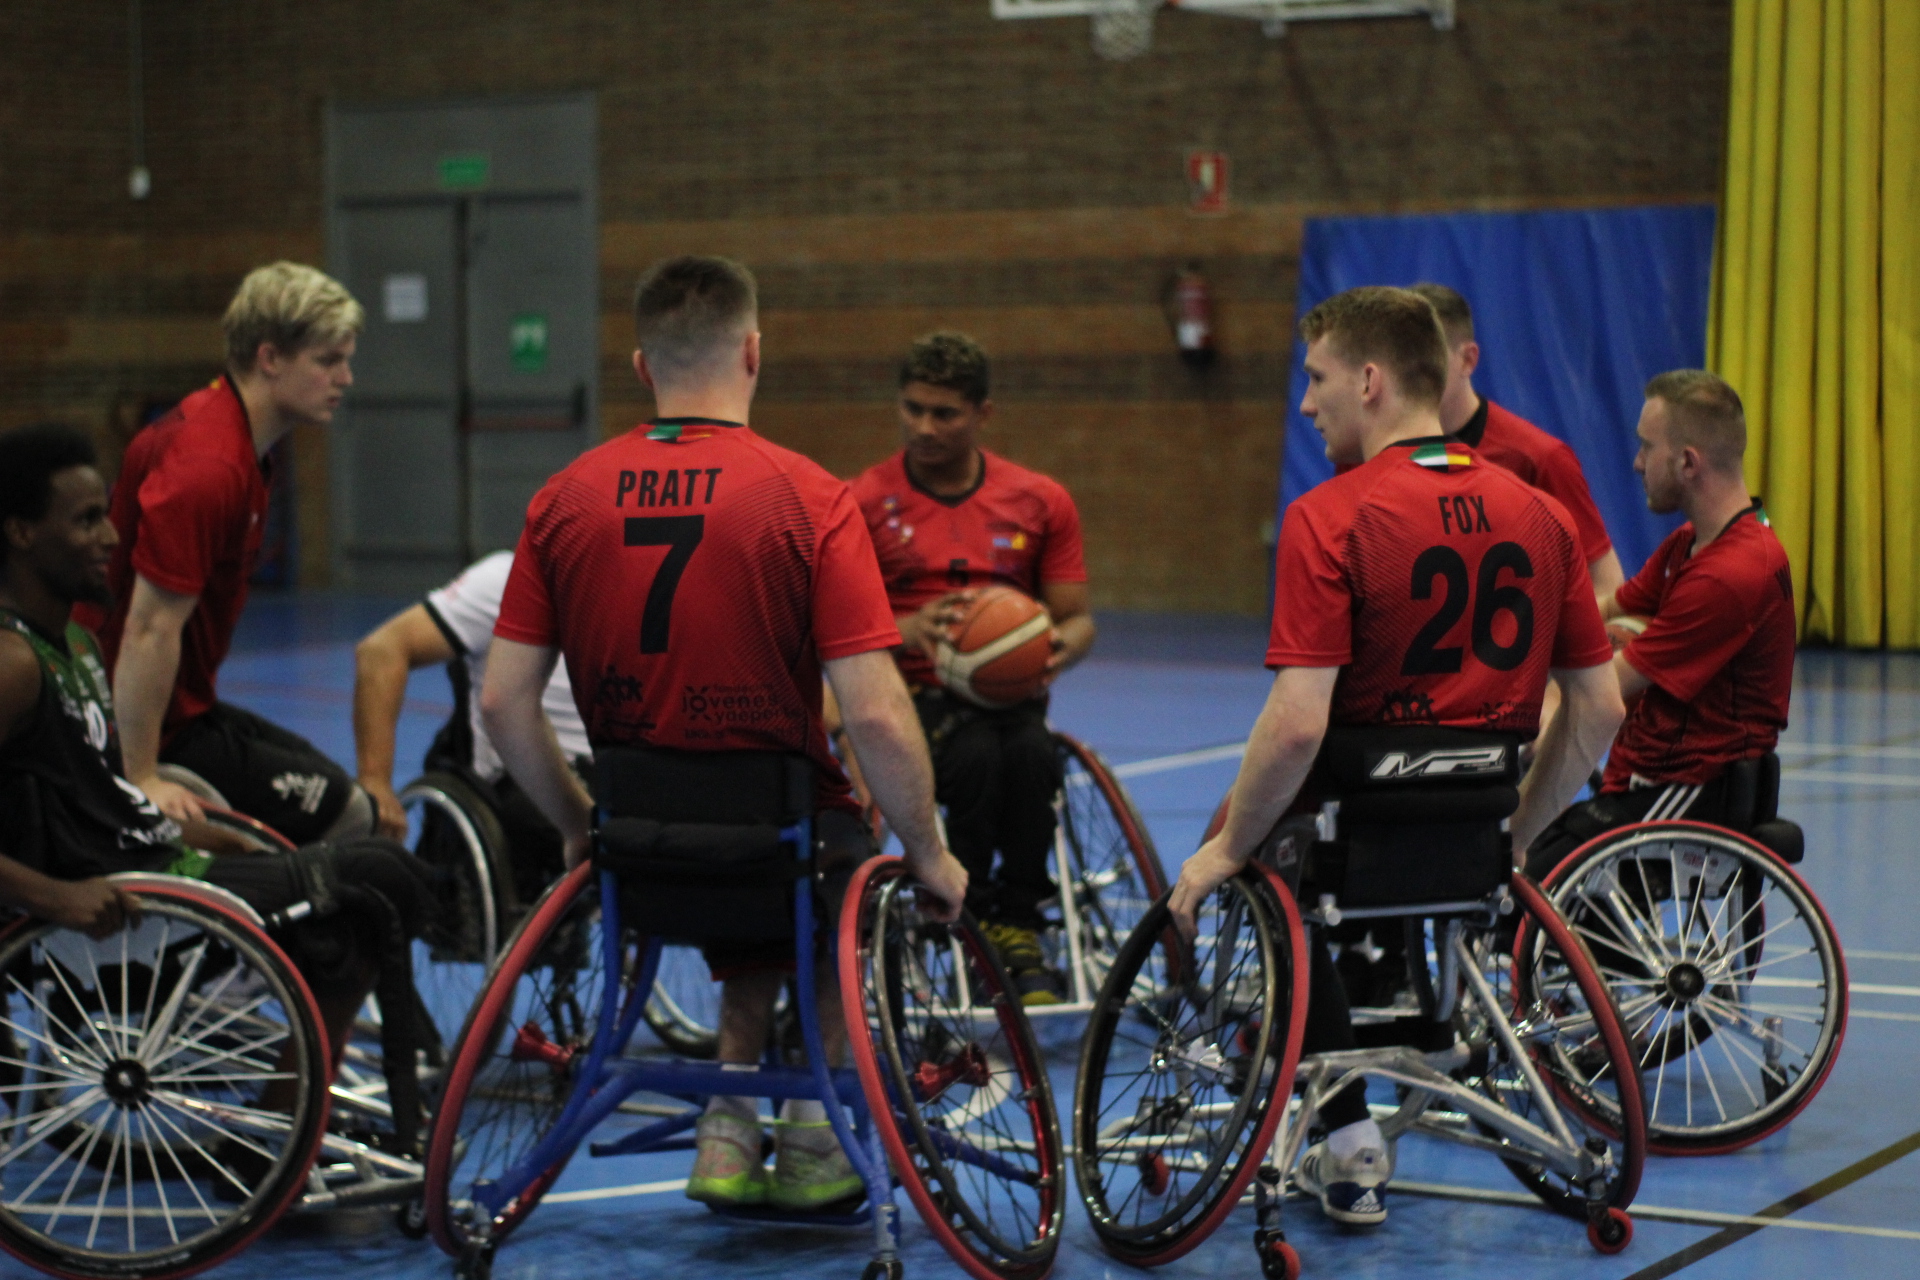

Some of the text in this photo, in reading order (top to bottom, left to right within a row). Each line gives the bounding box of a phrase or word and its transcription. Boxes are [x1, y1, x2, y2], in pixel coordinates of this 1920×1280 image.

[615, 468, 723, 508] PRATT
[1438, 495, 1492, 535] FOX
[623, 514, 705, 655] 7
[1400, 541, 1534, 677] 26
